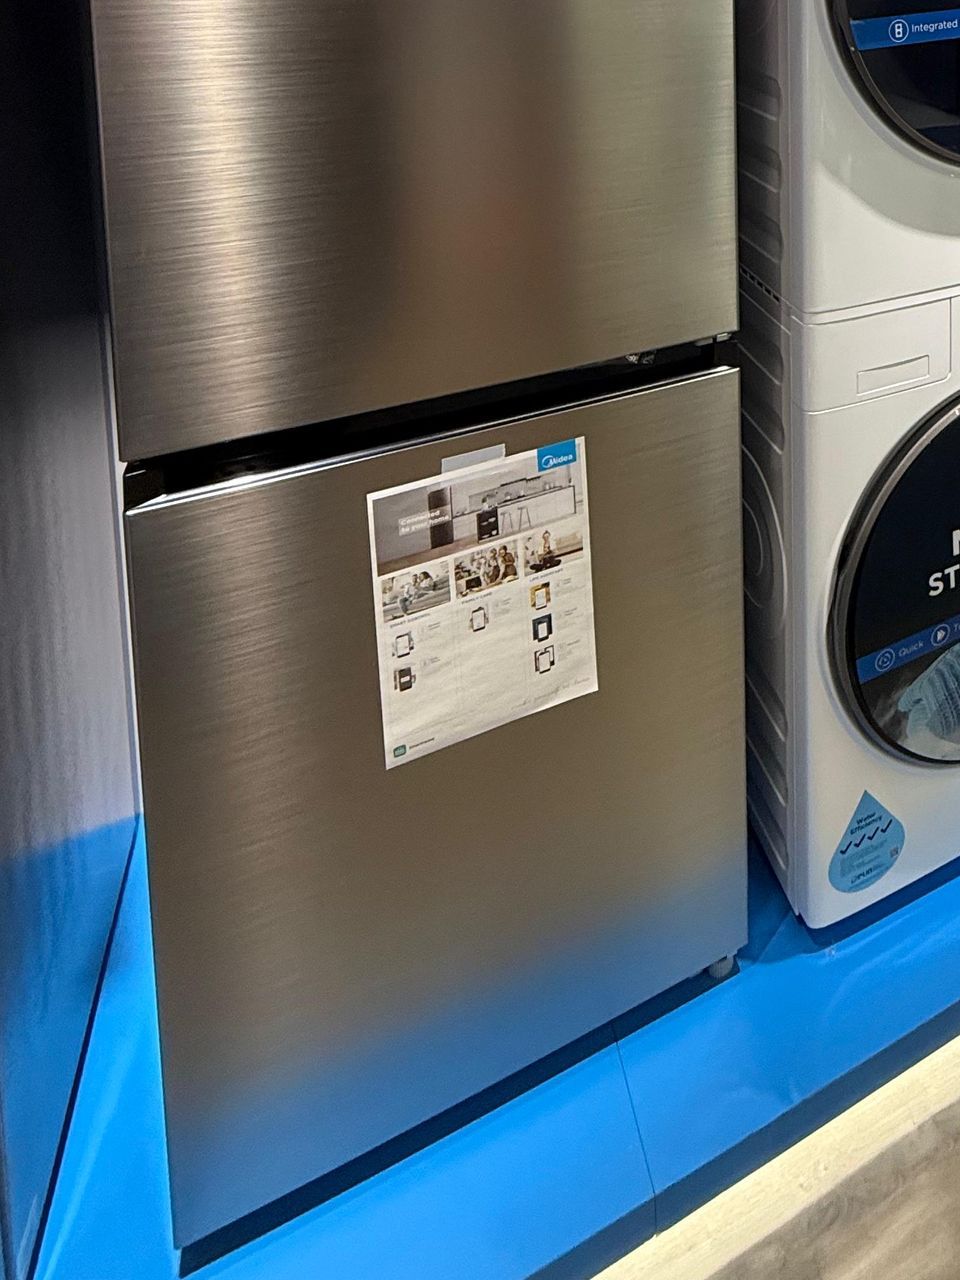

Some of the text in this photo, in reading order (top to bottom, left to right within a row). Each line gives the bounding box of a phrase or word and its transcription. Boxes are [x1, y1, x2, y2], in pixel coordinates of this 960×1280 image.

[911, 17, 958, 33] Integrated
[541, 454, 574, 468] Midea
[899, 640, 924, 657] Quick
